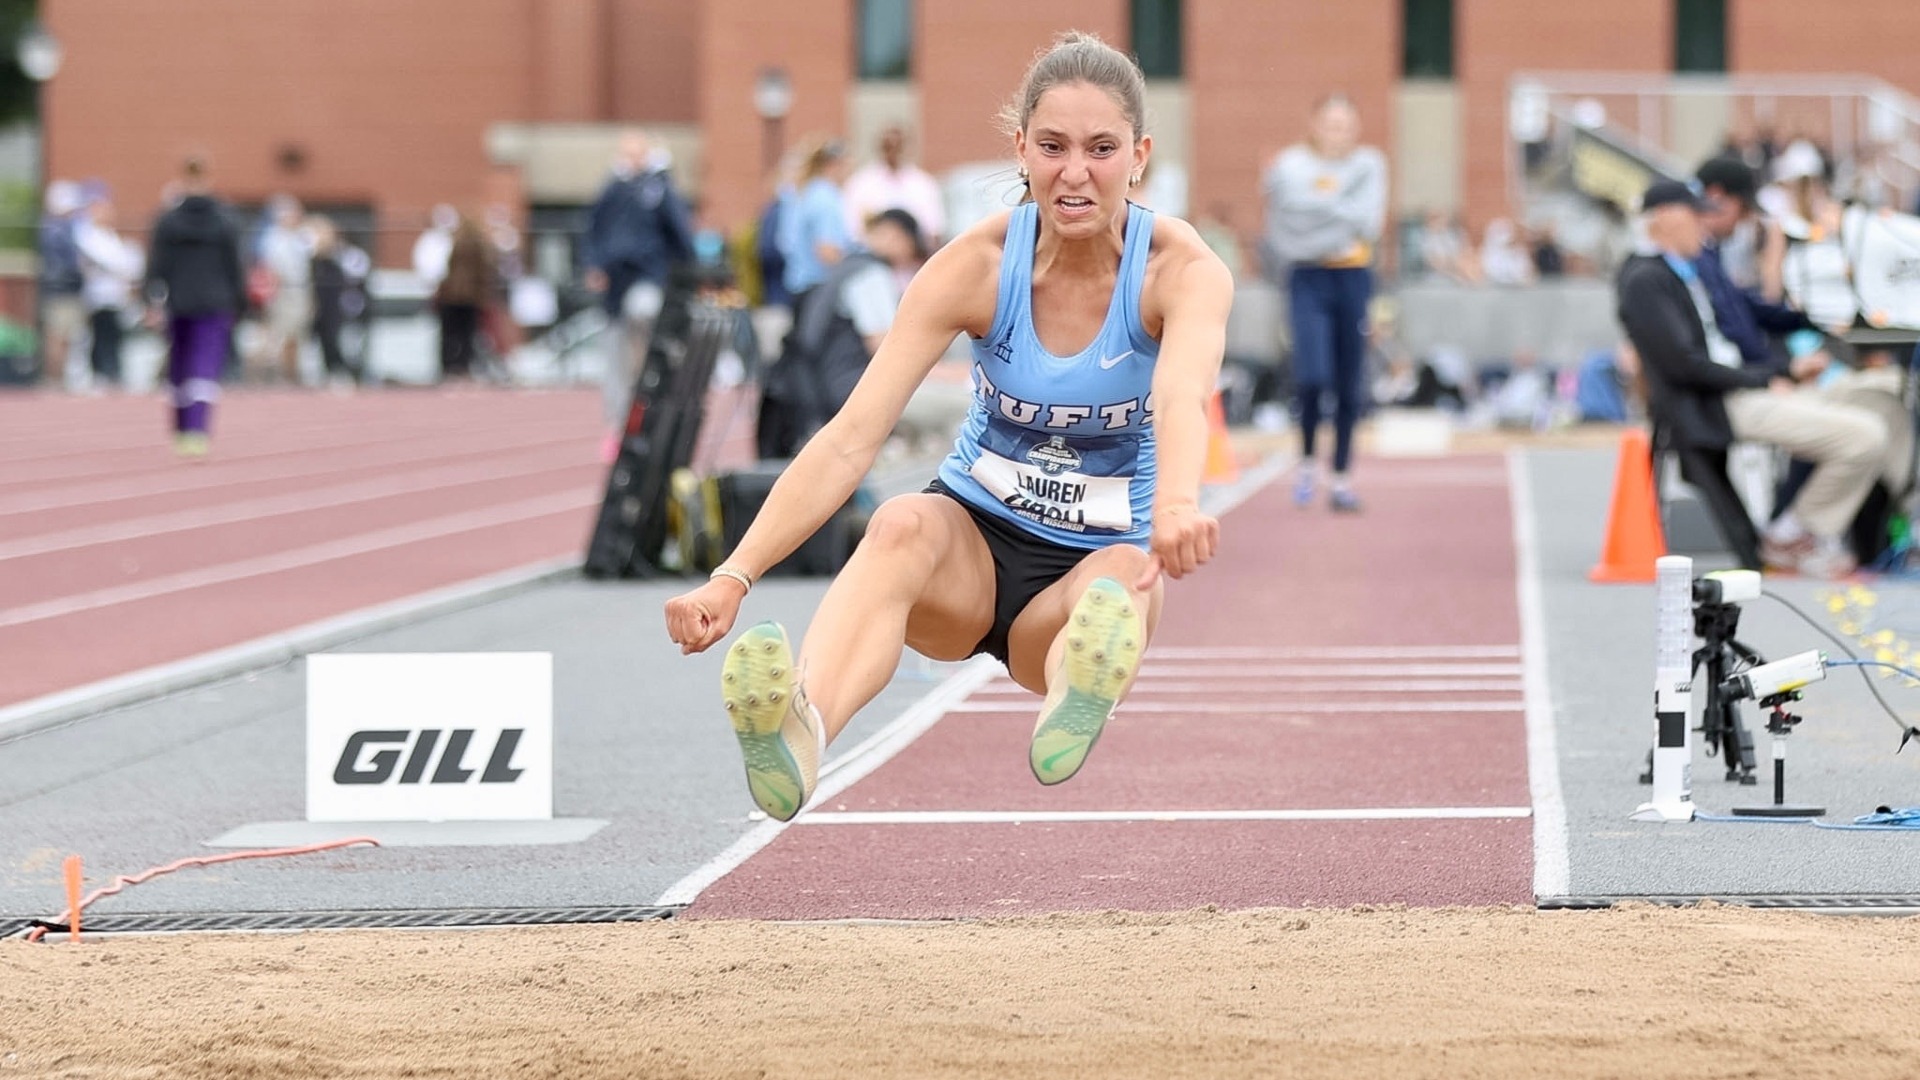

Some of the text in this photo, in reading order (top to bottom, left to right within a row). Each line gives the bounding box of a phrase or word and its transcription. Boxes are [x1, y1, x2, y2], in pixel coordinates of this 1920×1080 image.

[1016, 471, 1087, 504] LAUREN
[1042, 516, 1086, 533] WISCONSIN
[333, 729, 526, 785] GILL
